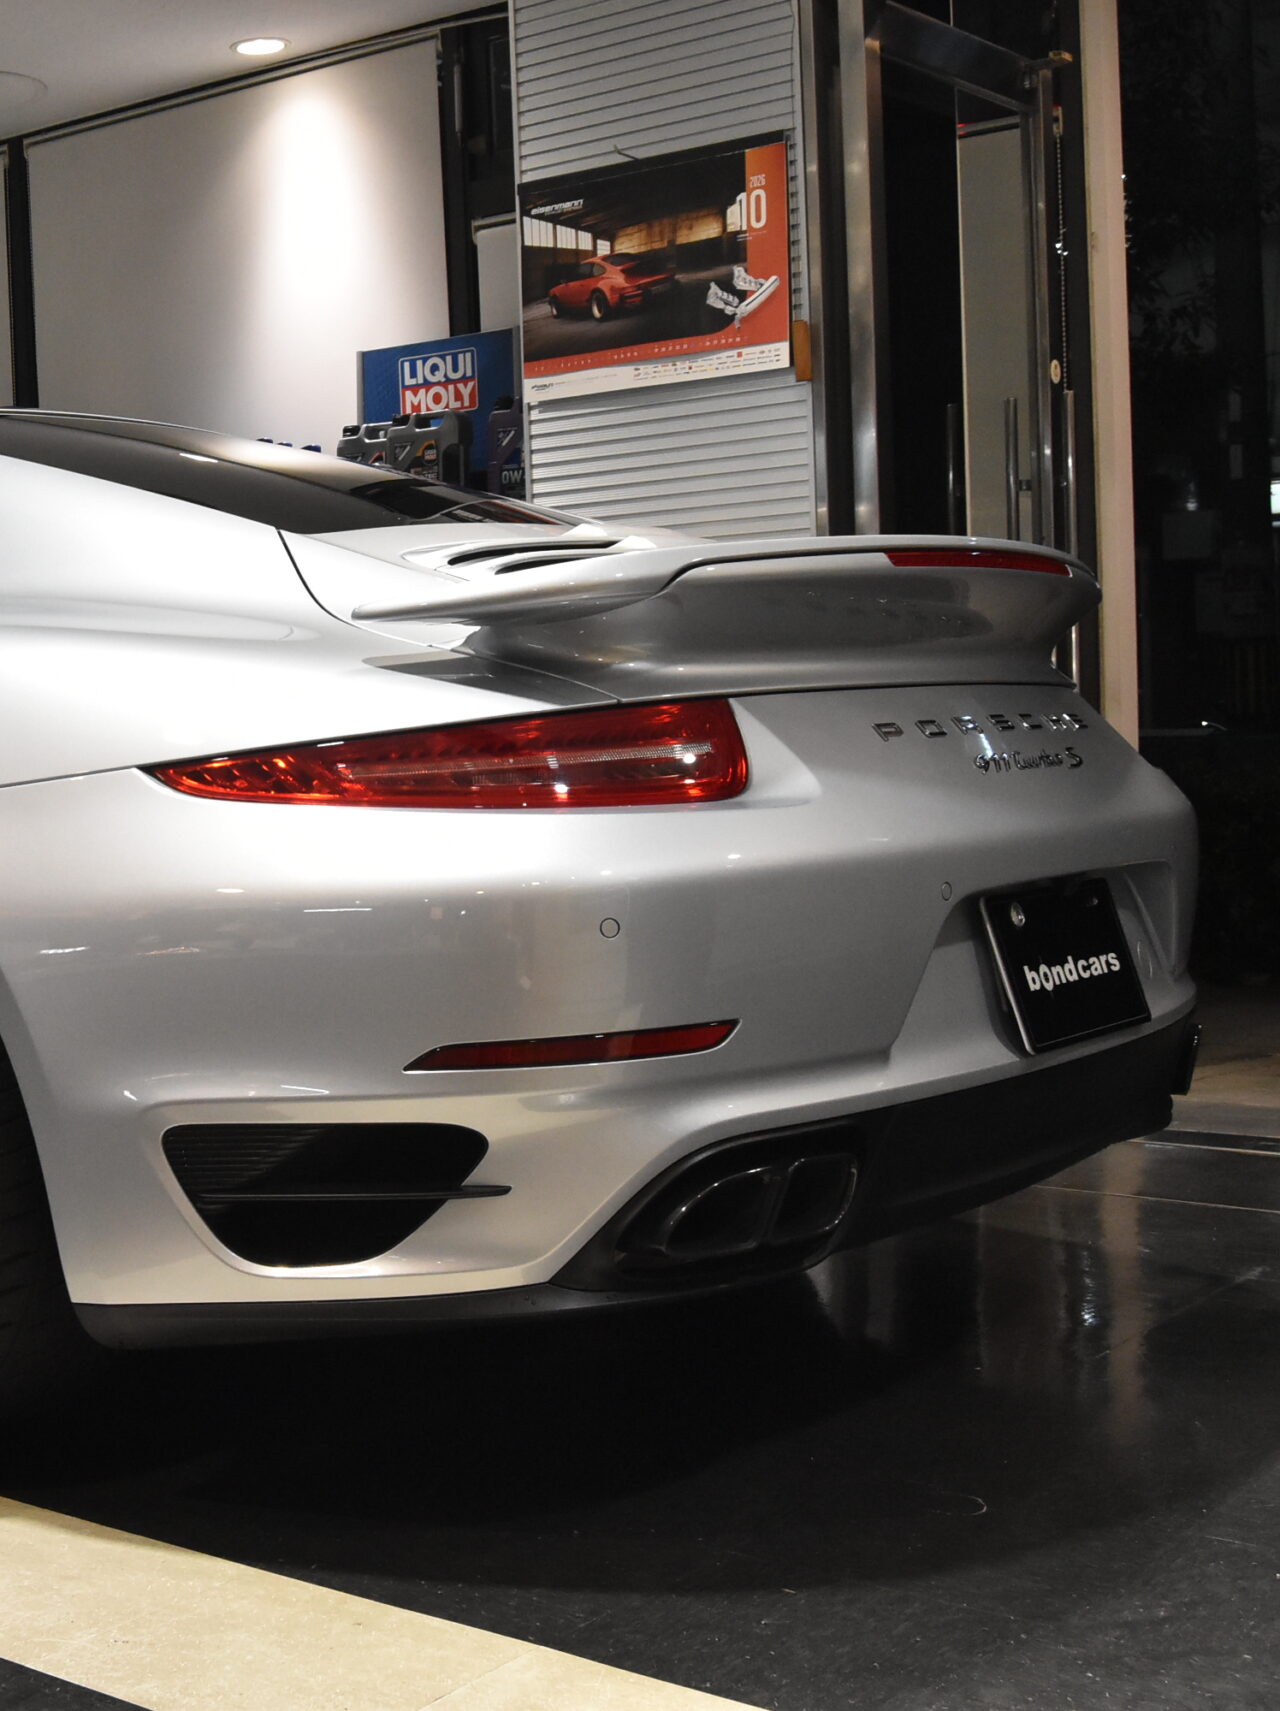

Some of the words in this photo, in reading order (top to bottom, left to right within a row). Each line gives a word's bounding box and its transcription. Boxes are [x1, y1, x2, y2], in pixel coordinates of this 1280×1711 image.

[736, 189, 767, 229] 10
[404, 352, 473, 385] LIQUI
[405, 381, 475, 415] MOLY
[872, 713, 1089, 742] PORSCHE
[974, 752, 1011, 775] 911
[1065, 747, 1084, 770] S
